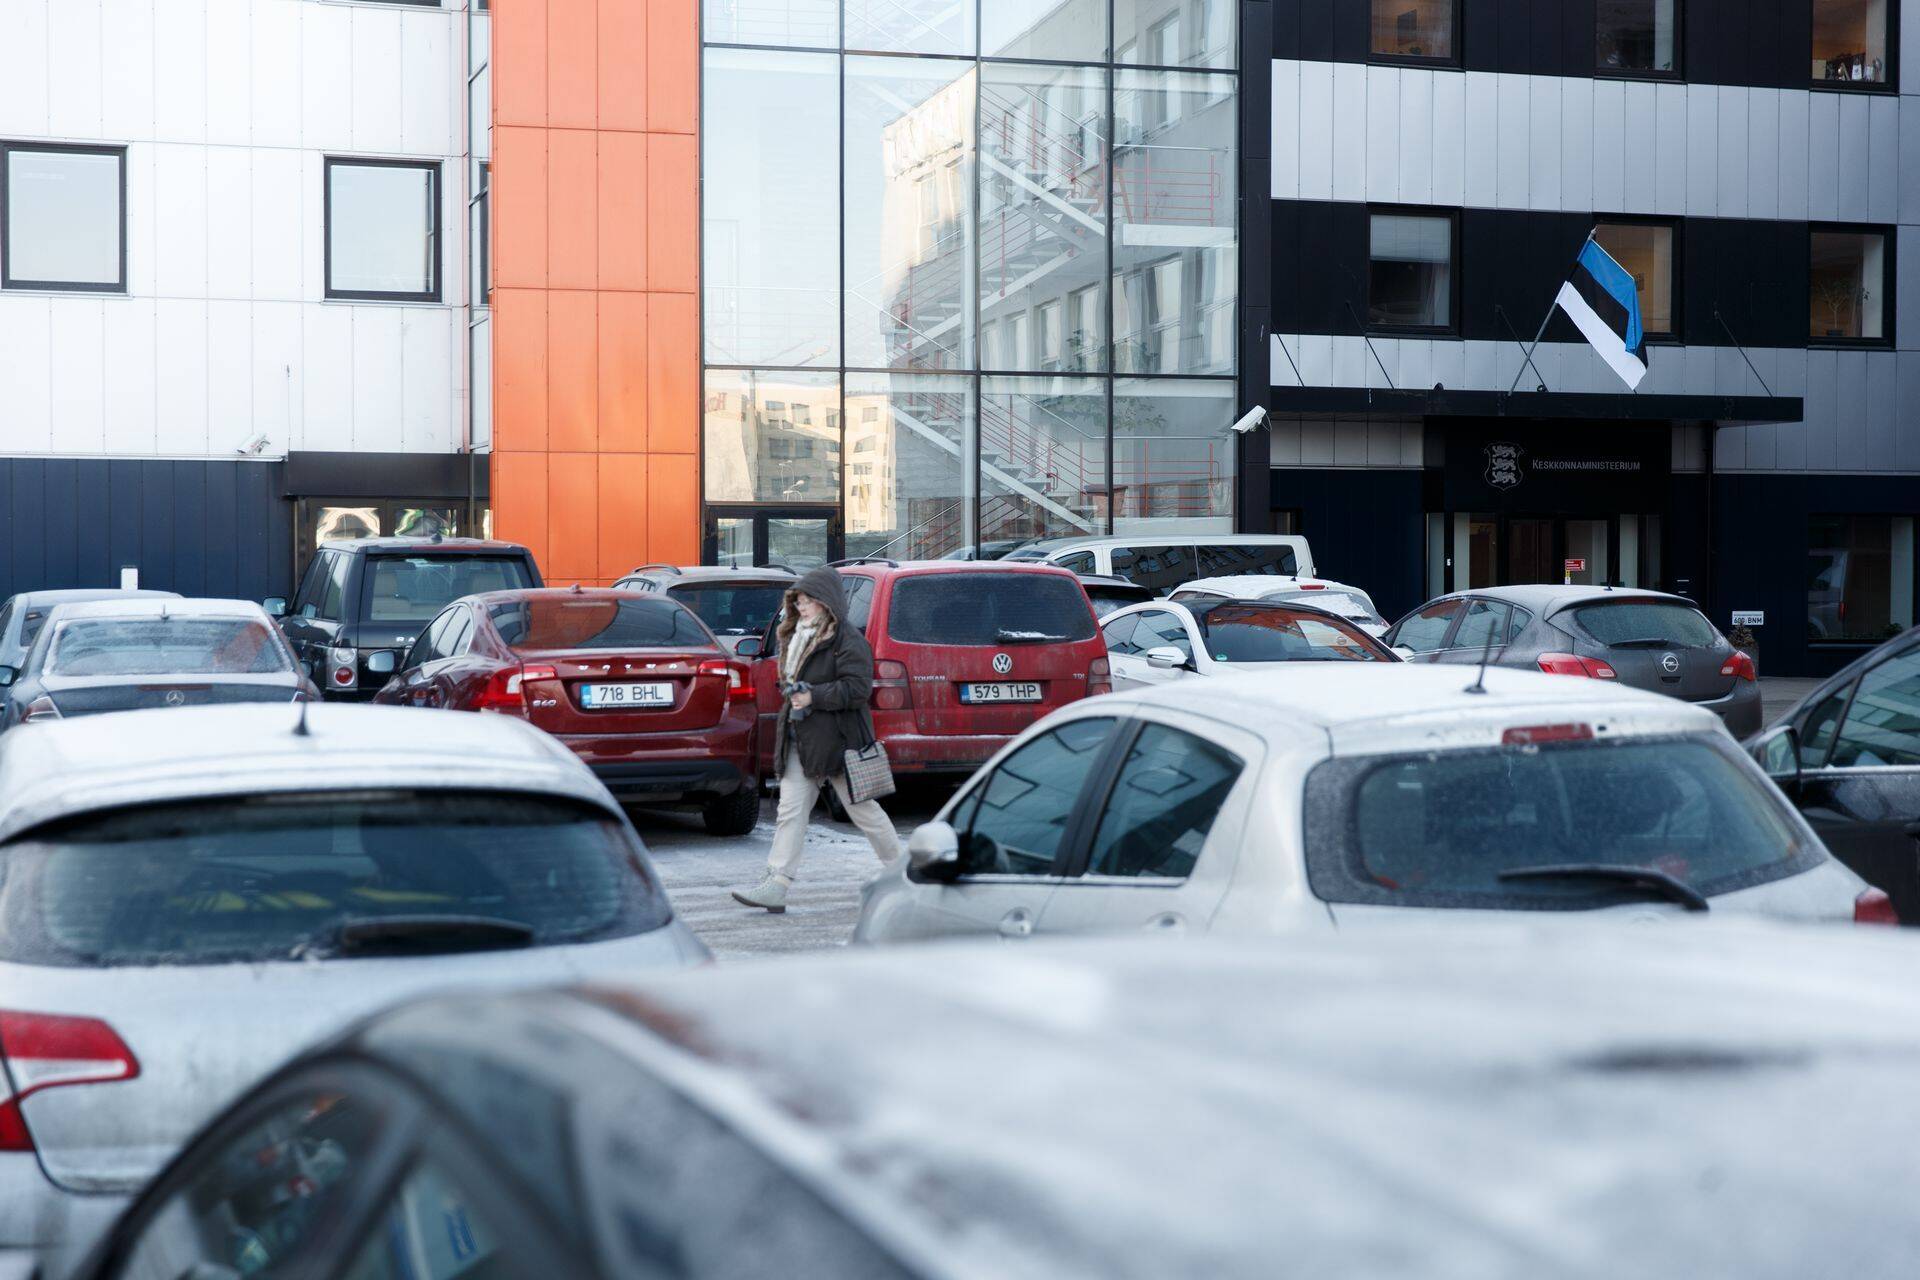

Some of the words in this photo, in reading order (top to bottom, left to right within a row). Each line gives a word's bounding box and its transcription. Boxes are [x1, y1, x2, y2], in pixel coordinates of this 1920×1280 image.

[1532, 459, 1641, 470] KESKKONNAMINISTEERIUM
[600, 686, 624, 701] 718
[632, 685, 663, 701] BHL
[974, 685, 1000, 699] 579
[1007, 684, 1037, 698] THP
